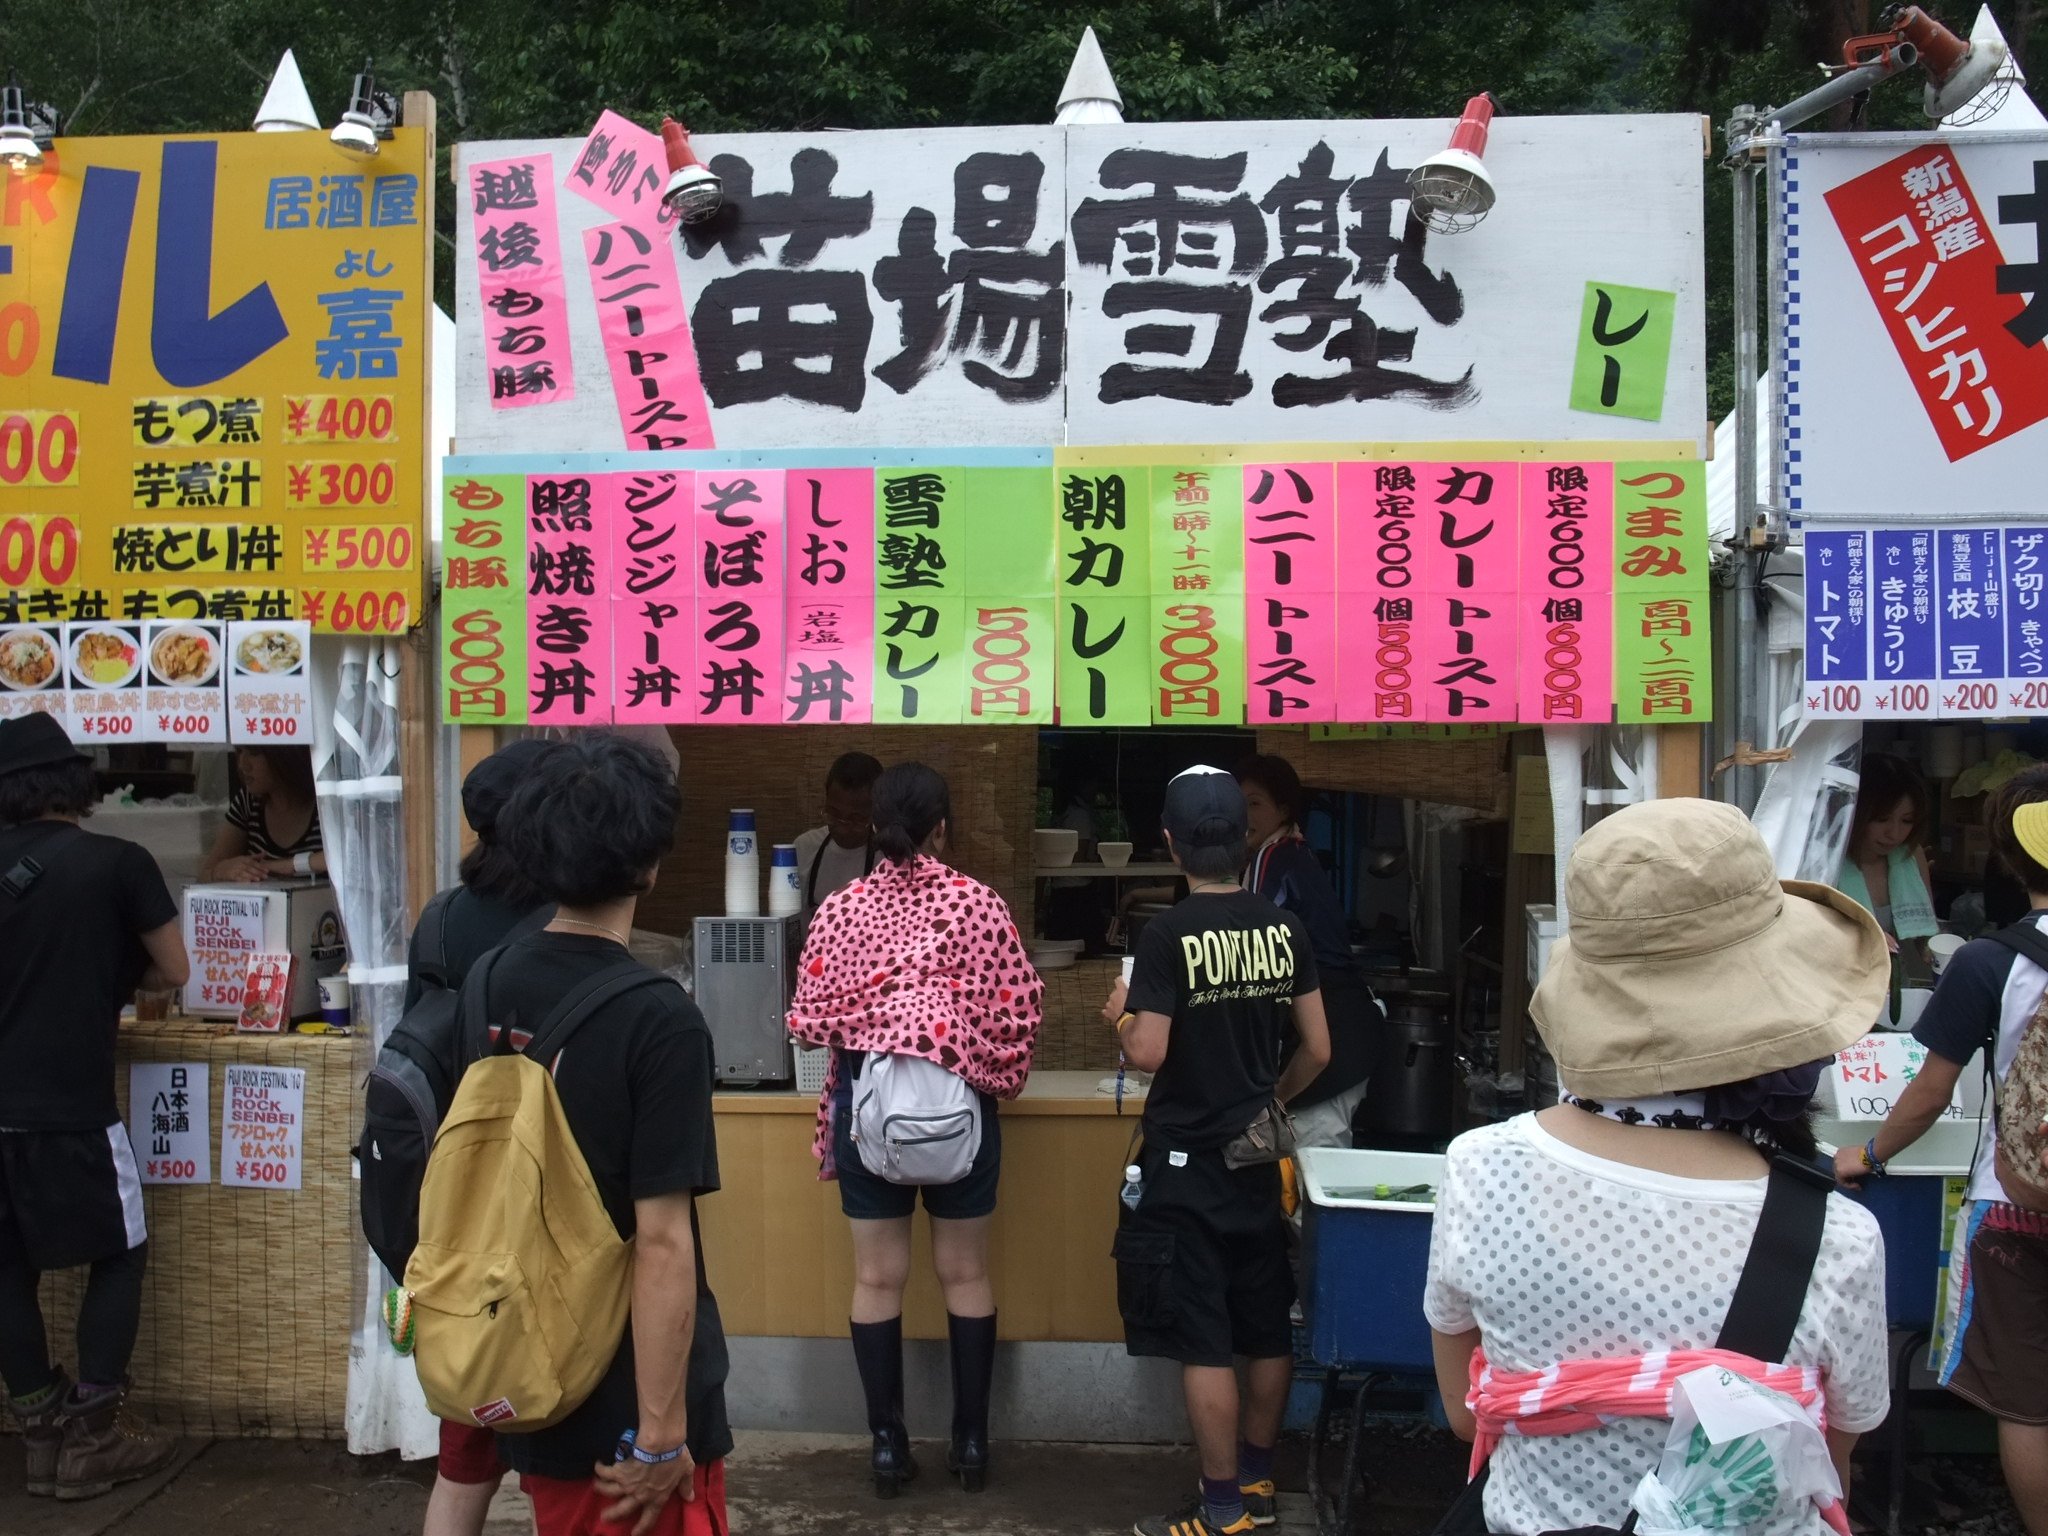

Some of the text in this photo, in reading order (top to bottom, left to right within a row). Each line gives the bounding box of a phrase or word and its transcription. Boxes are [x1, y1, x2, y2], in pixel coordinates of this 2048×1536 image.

[264, 172, 419, 231] 居酒屋
[1900, 154, 1986, 263] 新潟産
[0, 140, 289, 388] ル
[333, 247, 394, 279] よし
[474, 163, 557, 400] 越後もち豚
[677, 139, 1482, 413] 苗場雪塾
[315, 287, 404, 380] 嘉
[591, 224, 689, 451] ハニートースト
[1591, 287, 1649, 409] レー
[1859, 212, 2004, 438] コシヒカリ
[133, 397, 393, 444] もつ煮 ¥400
[133, 460, 394, 508] 芋煮汁 ¥300
[113, 525, 412, 573] 焼とり丼 ¥500
[1620, 471, 1688, 578] つまみ
[301, 589, 407, 634] ¥600
[445, 479, 509, 718] もち豚 600円
[530, 478, 596, 715] 照焼き丼
[624, 474, 682, 708] ジンジャー丼
[700, 479, 767, 716] そぼろ丼
[877, 473, 947, 719] 雪塾カレー
[1061, 474, 1126, 719] 朝カレー
[1248, 468, 1316, 718] ハニートースト
[1433, 467, 1497, 717] カレートースト
[1814, 547, 1842, 676] 冷し トマト
[1881, 546, 1909, 675] 冷し きゅうり
[2010, 534, 2044, 675] ザク切り きゃべつ
[970, 606, 1031, 717] 500円
[1159, 604, 1220, 718] 300円
[1807, 684, 1862, 713] ¥100
[1875, 684, 1930, 712] ¥100
[1943, 683, 1998, 710] ¥200
[82, 716, 133, 735] ¥500
[158, 715, 210, 734] ¥600
[245, 716, 298, 736] ¥300
[195, 915, 230, 927] FUJI
[195, 926, 243, 938] ROCK
[204, 899, 220, 915] ROCK
[221, 900, 248, 917] FESTIVAL
[195, 938, 256, 950] SENBEI
[205, 966, 248, 982] せんべ
[232, 1087, 269, 1100] FUJI
[242, 1070, 259, 1088] ROCK
[260, 1071, 288, 1089] FESTIVAL
[1841, 1062, 1888, 1084] トマト
[152, 1091, 171, 1155] 八海山
[170, 1068, 190, 1132] 日本酒
[232, 1099, 281, 1112] ROCK
[232, 1111, 295, 1125] SENBEI
[1850, 1097, 1895, 1116] 100
[227, 1124, 288, 1142] フジロック
[147, 1160, 196, 1179] ¥500
[236, 1161, 287, 1183] ¥500
